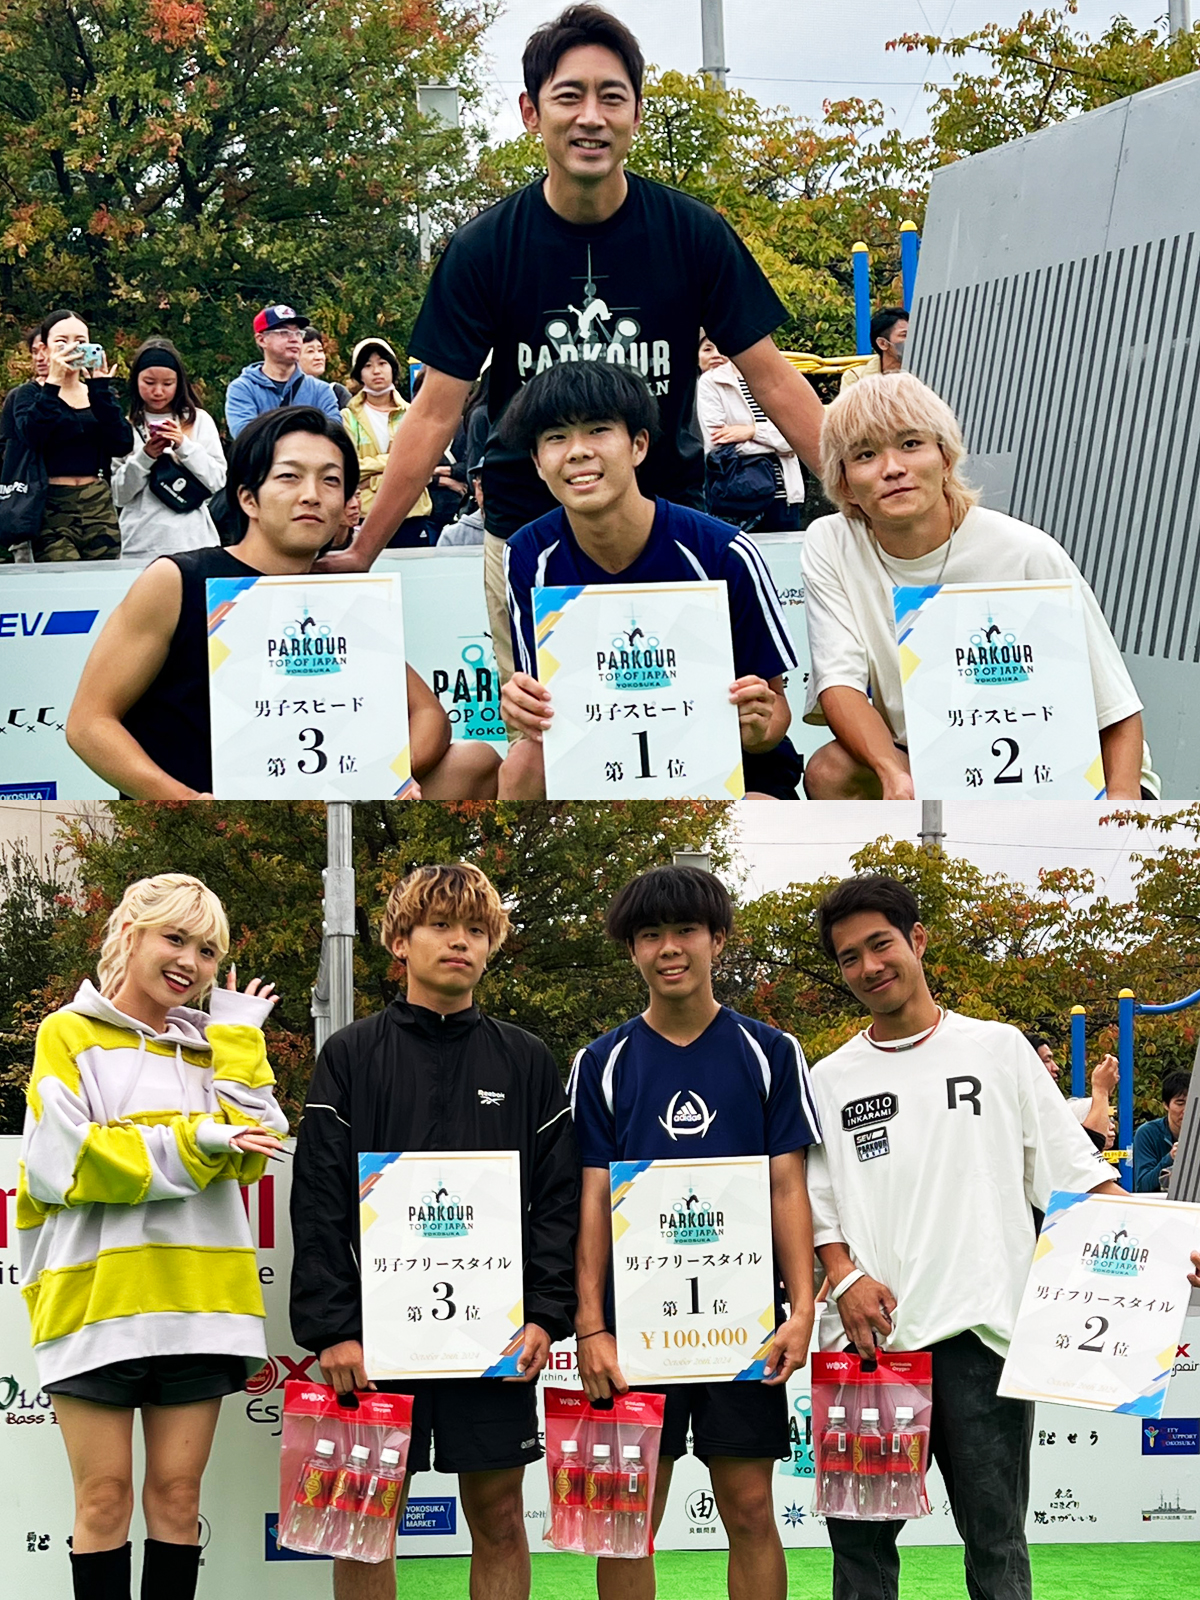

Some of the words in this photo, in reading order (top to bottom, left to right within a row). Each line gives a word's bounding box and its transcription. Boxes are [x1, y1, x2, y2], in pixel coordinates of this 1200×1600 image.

[268, 636, 347, 657] PARKOUR
[268, 659, 291, 668] TOP
[294, 658, 310, 667] OF
[312, 657, 347, 667] JAPAN
[597, 648, 676, 670] PARKOUR
[955, 645, 1034, 666] PARKOUR
[598, 672, 620, 682] TOP
[624, 671, 639, 681] OF
[642, 670, 677, 680] JAPAN
[957, 667, 979, 677] TOP
[982, 666, 998, 676] OF
[1000, 665, 1034, 675] JAPAN
[254, 697, 364, 718] 男子スピード
[585, 700, 695, 722] 男子スピード
[947, 706, 1054, 728] 男子スピード
[845, 1096, 892, 1118] TOKIO
[847, 1108, 892, 1127] INKARAMI
[856, 1133, 872, 1144] SEV
[408, 1205, 474, 1222] PARKOUR
[660, 1211, 724, 1229] PARKOUR
[409, 1223, 427, 1231] TOP
[445, 1222, 474, 1230] JAPAN
[680, 1229, 694, 1237] OF
[695, 1228, 724, 1237] JAPAN
[1082, 1242, 1150, 1263] PARKOUR
[374, 1256, 512, 1272] 男子フリースタイル
[625, 1252, 762, 1271] 男子フリースタイル
[1080, 1258, 1099, 1267] TOP
[1100, 1260, 1113, 1269] OF
[1115, 1262, 1146, 1272] JAPAN
[1036, 1284, 1175, 1313] 男子フリースタイル
[825, 1361, 848, 1371] WOX
[541, 1374, 567, 1382] ithin,
[406, 1519, 437, 1528] MARKET
